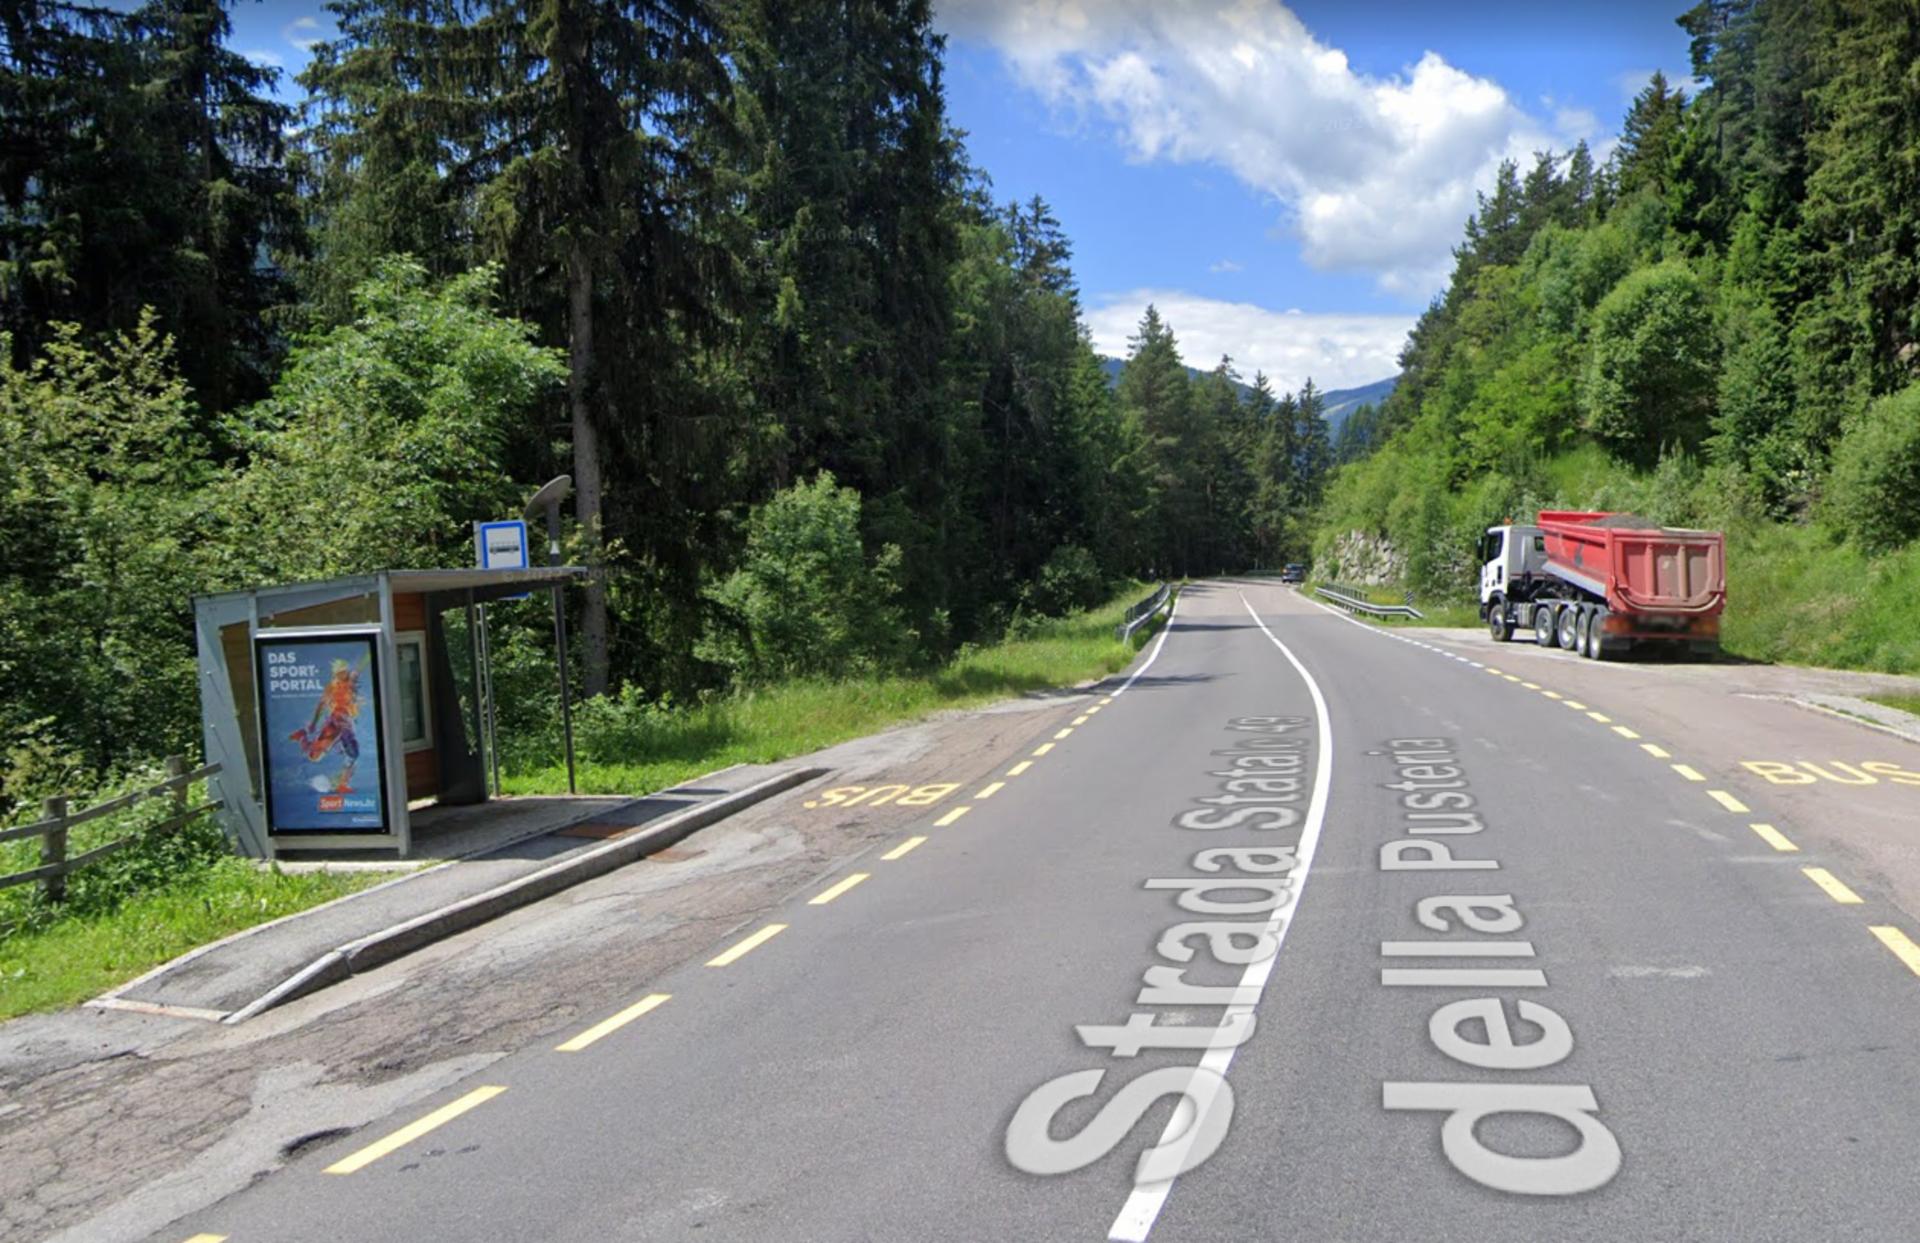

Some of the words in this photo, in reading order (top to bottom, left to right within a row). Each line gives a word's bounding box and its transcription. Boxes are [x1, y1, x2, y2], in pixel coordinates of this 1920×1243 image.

[268, 651, 297, 664] DAS
[269, 664, 320, 678] SPORT-
[270, 679, 324, 692] PORTAL
[1737, 760, 1920, 786] BUS
[803, 783, 963, 808] BUS
